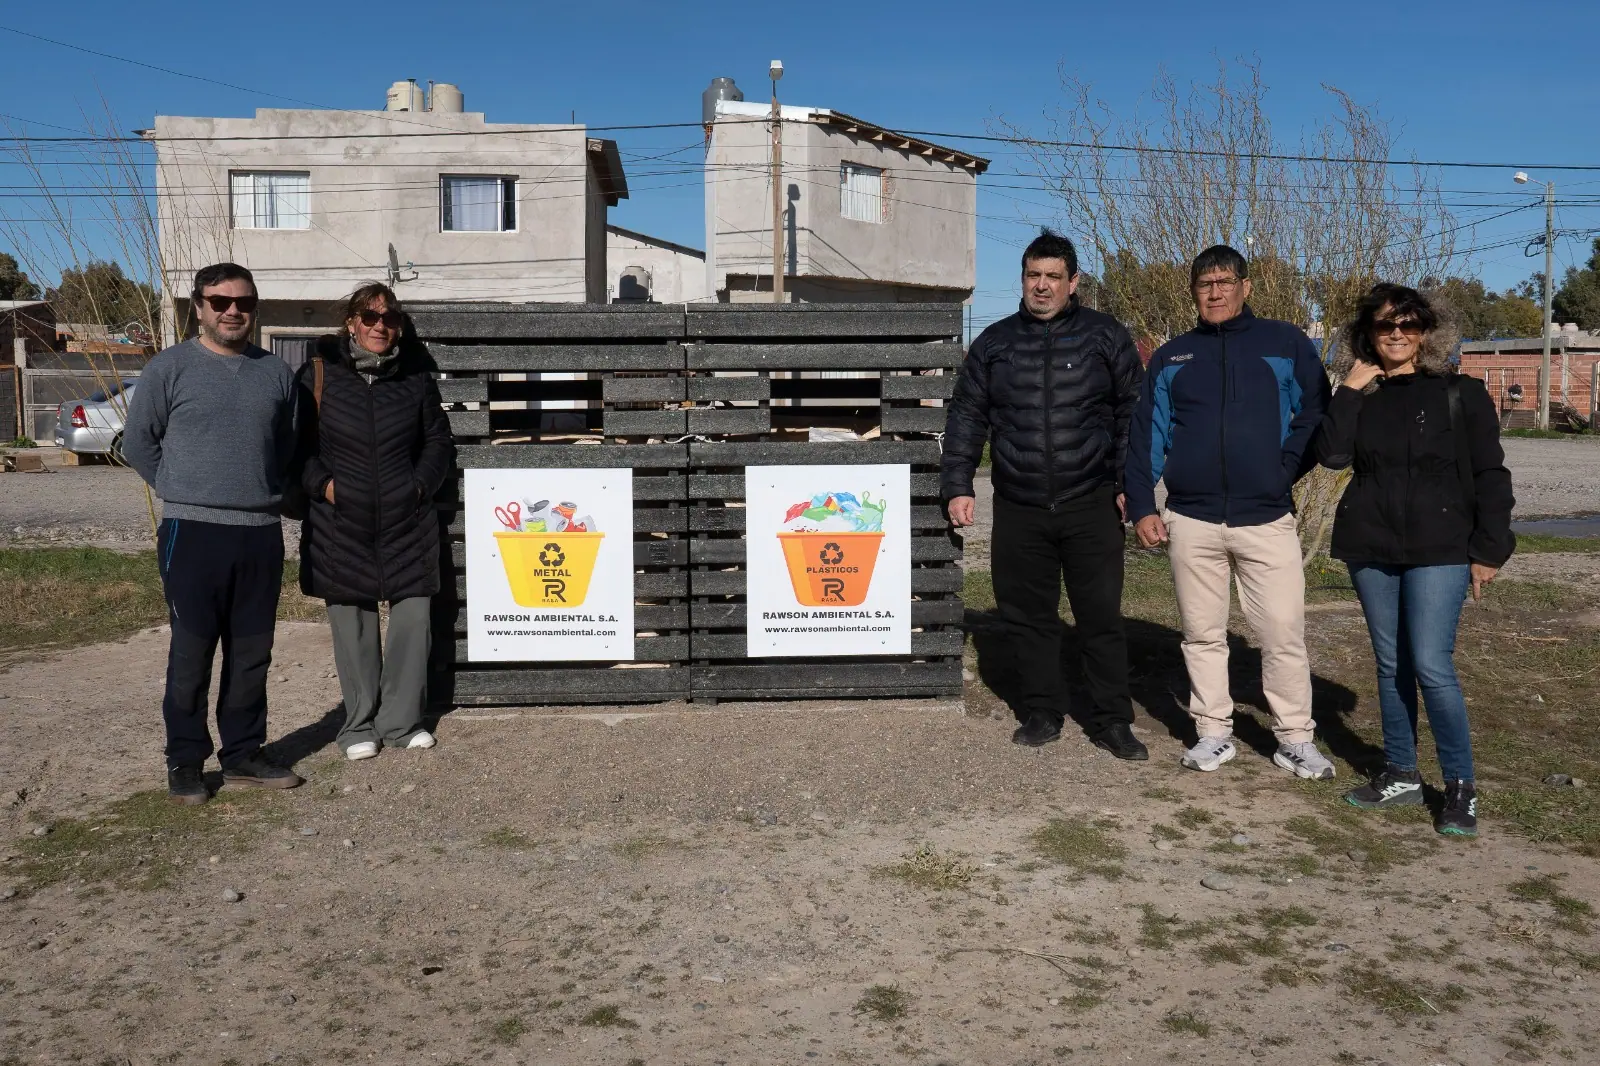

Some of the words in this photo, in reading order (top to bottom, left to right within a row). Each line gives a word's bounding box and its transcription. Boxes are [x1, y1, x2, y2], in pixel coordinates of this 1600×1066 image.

[533, 568, 572, 577] METAL
[483, 614, 531, 622] RAWSON
[533, 614, 596, 622] AMBIENTAL
[598, 614, 619, 622] S.A.
[762, 611, 809, 620] RAWSON
[811, 611, 872, 619] AMBIENTAL
[874, 610, 895, 618] S.A.
[764, 625, 891, 633] www.rawsonambiental.com
